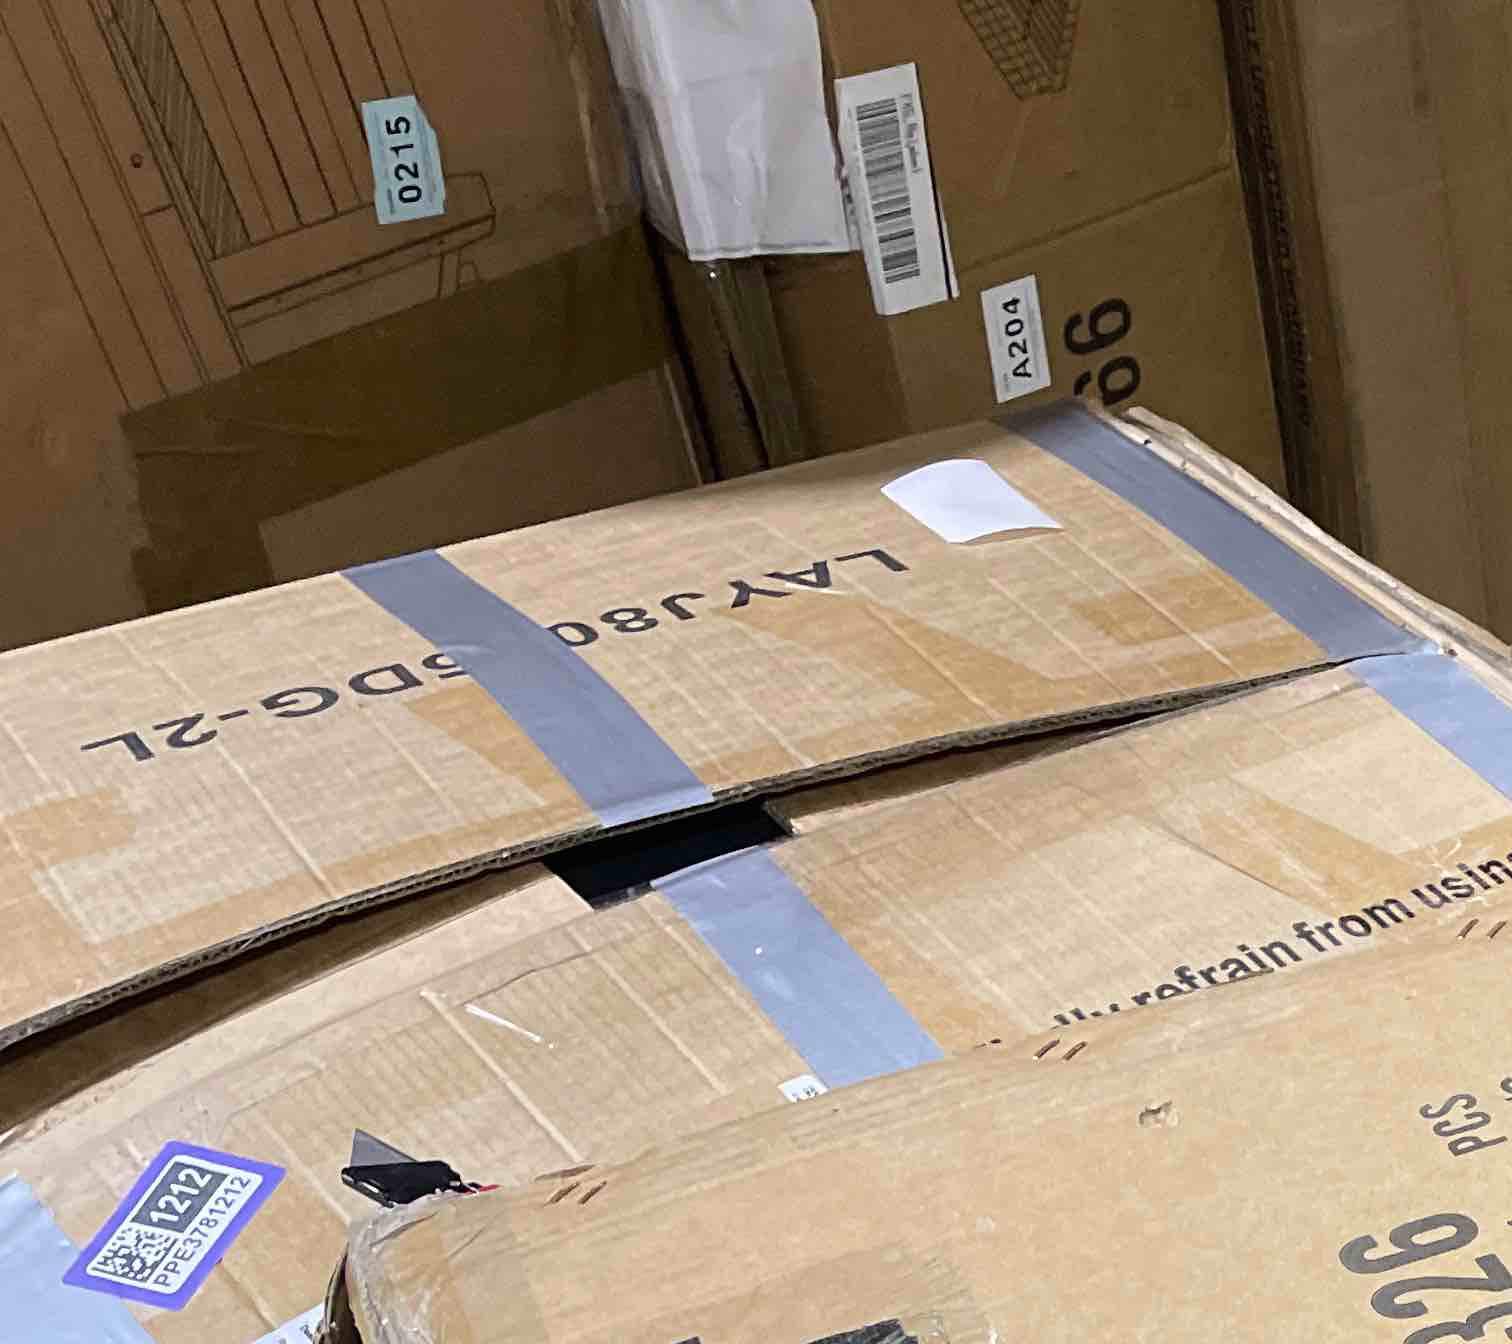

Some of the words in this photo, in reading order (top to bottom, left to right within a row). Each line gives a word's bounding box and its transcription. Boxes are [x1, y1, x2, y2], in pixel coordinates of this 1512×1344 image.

[385, 115, 423, 204] 0215
[1002, 297, 1032, 378] A204
[1293, 896, 1417, 954] from
[1418, 1091, 1507, 1157] PCS
[149, 1167, 214, 1225] 1212
[152, 1174, 252, 1288] PPE3781212
